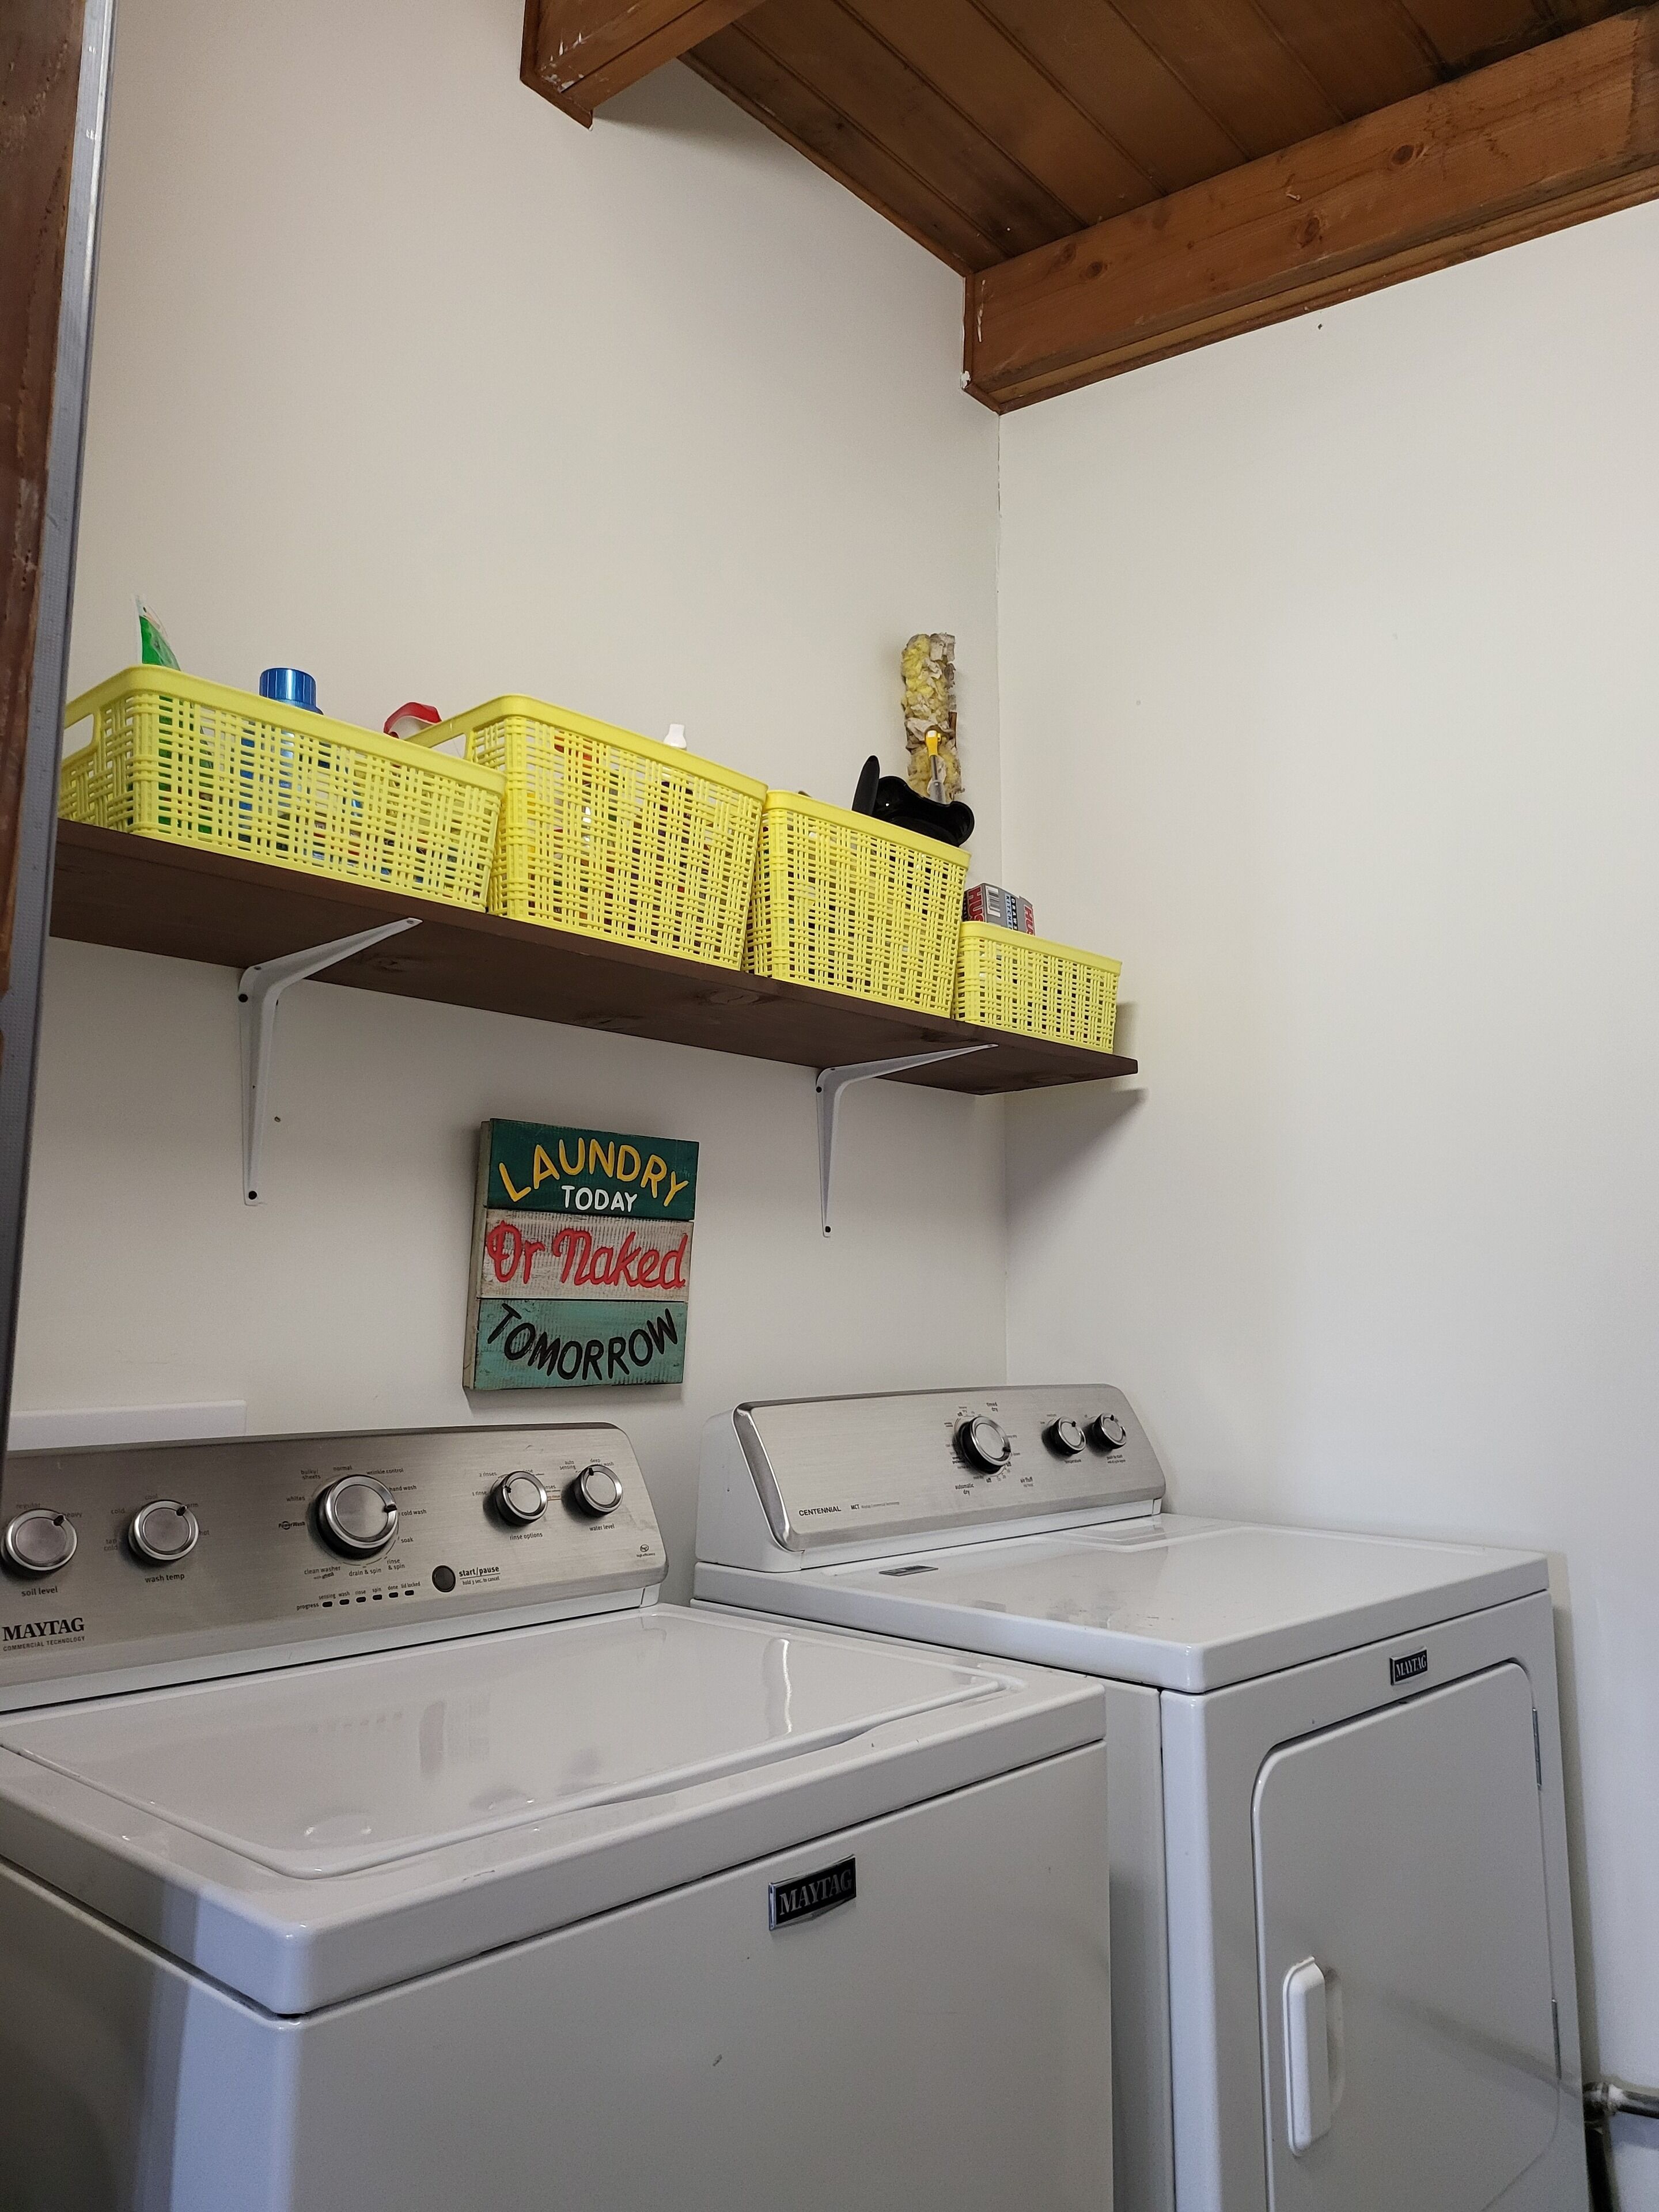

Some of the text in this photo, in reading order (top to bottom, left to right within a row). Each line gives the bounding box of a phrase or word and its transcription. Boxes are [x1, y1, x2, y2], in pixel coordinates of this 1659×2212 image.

[499, 1137, 689, 1207] LAUNDRY
[562, 1185, 638, 1212] TODAY
[487, 1220, 688, 1290] Or Naked
[487, 1303, 678, 1380] TOMORROW
[798, 1506, 842, 1516] CENTENNIAL
[524, 1532, 543, 1540] options
[145, 1573, 185, 1583] wash temp
[349, 1568, 363, 1577] drain
[459, 1565, 499, 1577] start/pause
[21, 1585, 58, 1597] soil level
[296, 1603, 319, 1611] progress
[2, 1617, 85, 1641] MAYTAG
[3, 1636, 85, 1652] COMMERCIAL TECHNOLOGY
[1396, 1654, 1426, 1677] MAYTAG
[779, 1869, 852, 1915] MAYTAG
